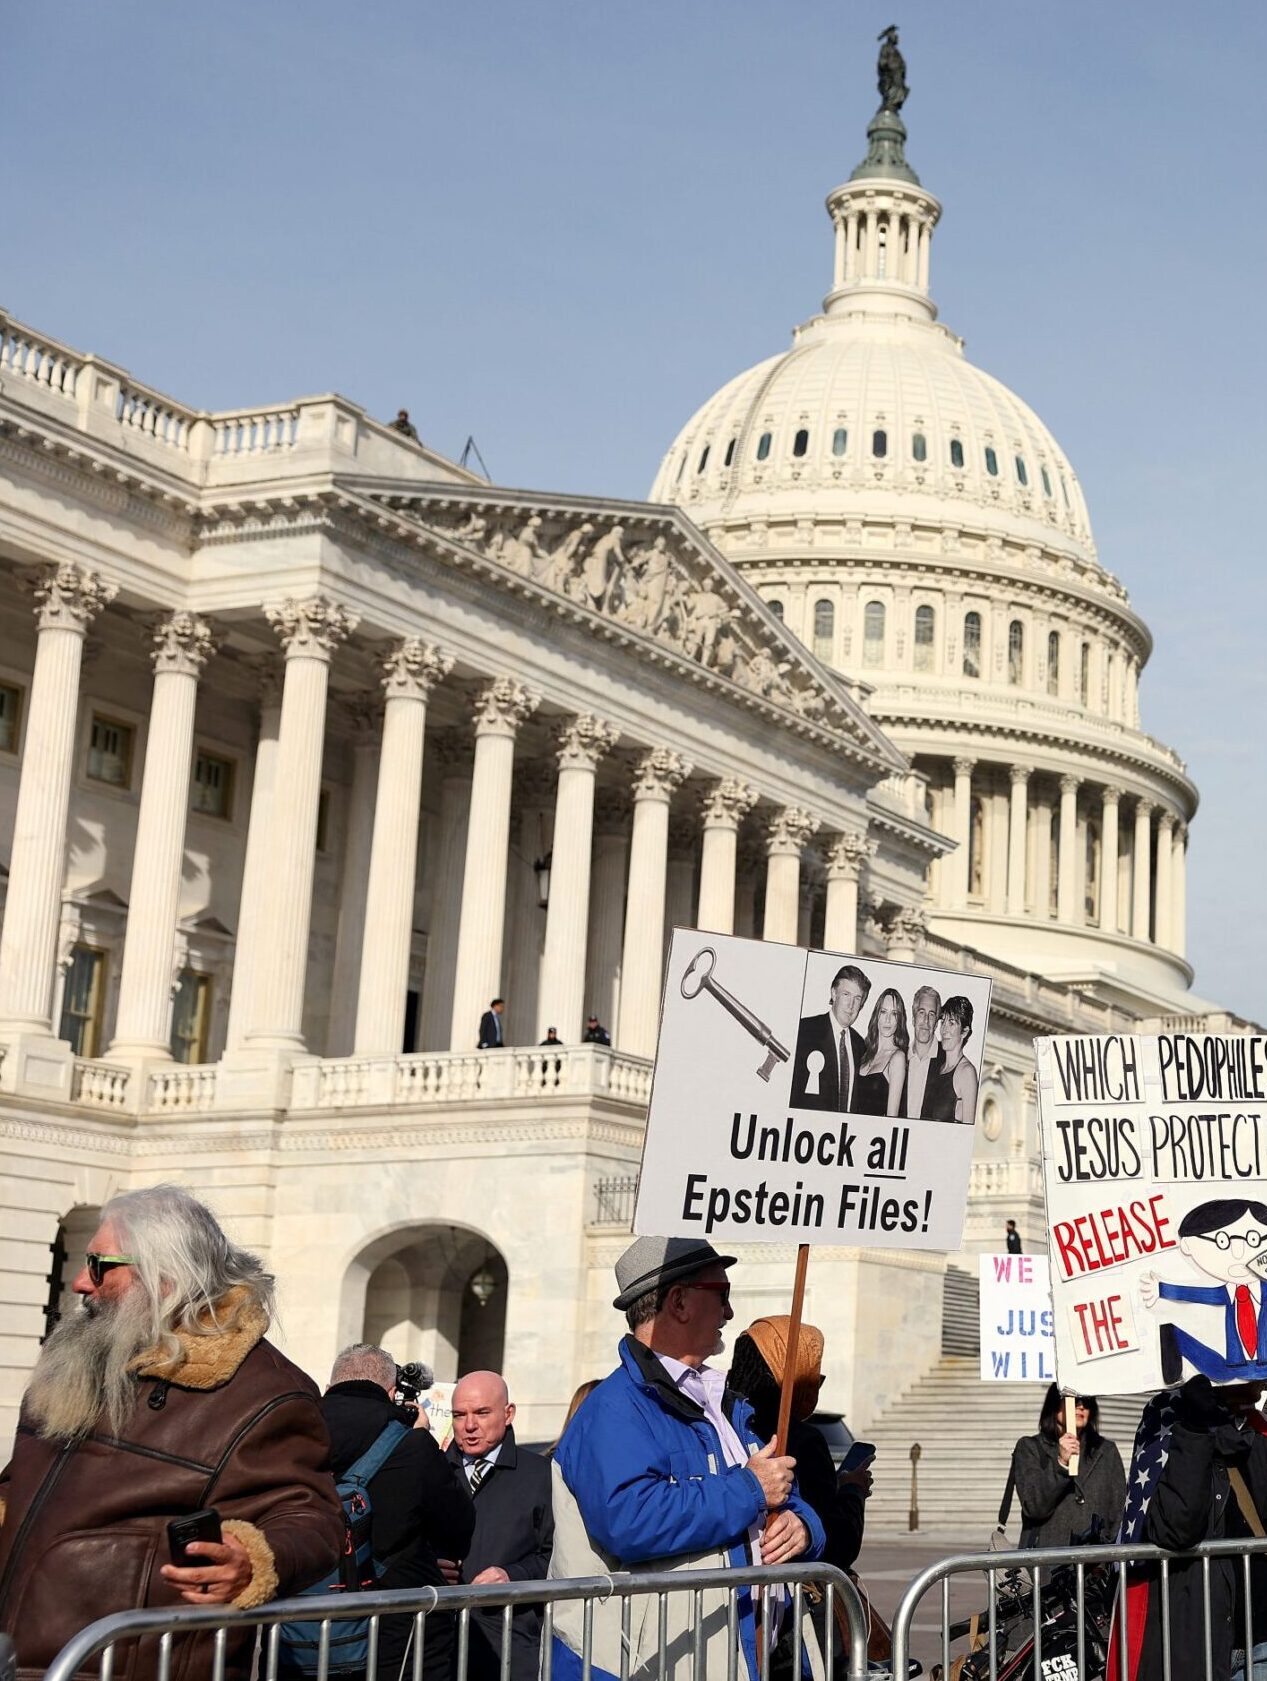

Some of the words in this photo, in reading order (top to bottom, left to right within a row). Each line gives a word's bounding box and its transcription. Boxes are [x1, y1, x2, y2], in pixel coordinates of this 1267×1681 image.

[1053, 1036, 1140, 1101] WHICH
[729, 1112, 857, 1167] Unlock
[866, 1126, 909, 1172] all
[1056, 1117, 1142, 1182] JESUS
[682, 1173, 825, 1234] Epstein
[837, 1184, 933, 1233] Files!
[1053, 1195, 1177, 1278] RELEASE
[993, 1256, 1033, 1283] WE
[1074, 1295, 1129, 1356] THE
[1041, 1653, 1077, 1676] FCK
